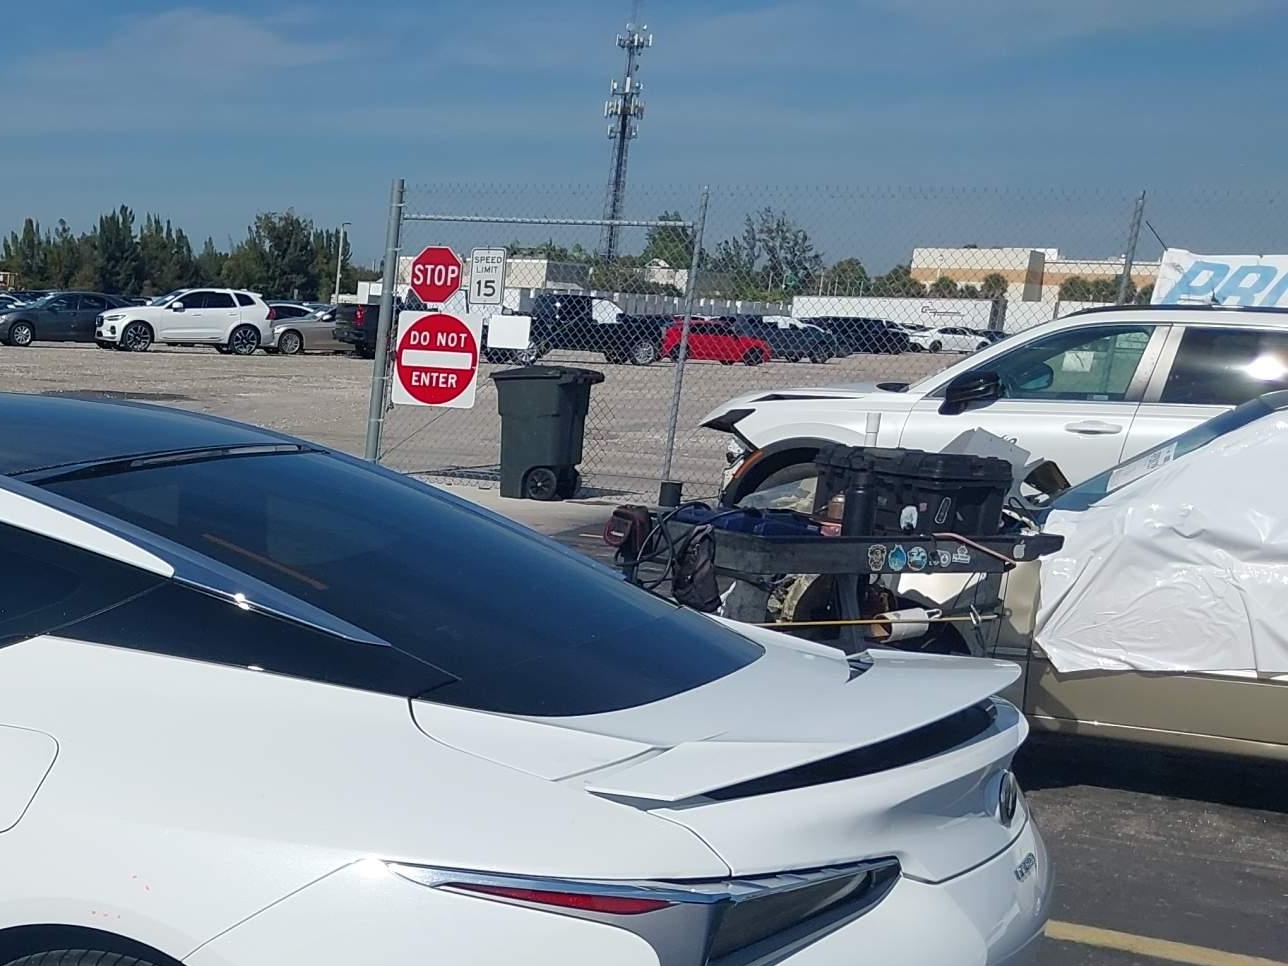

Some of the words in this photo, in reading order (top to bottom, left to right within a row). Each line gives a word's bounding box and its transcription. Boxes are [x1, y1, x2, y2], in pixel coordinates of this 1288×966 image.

[474, 256, 502, 264] SPEED
[413, 264, 459, 286] STOP
[476, 266, 498, 274] LIMIT
[476, 280, 496, 297] 15
[410, 330, 430, 346] DO
[436, 332, 468, 348] NOT
[411, 371, 458, 389] ENTER
